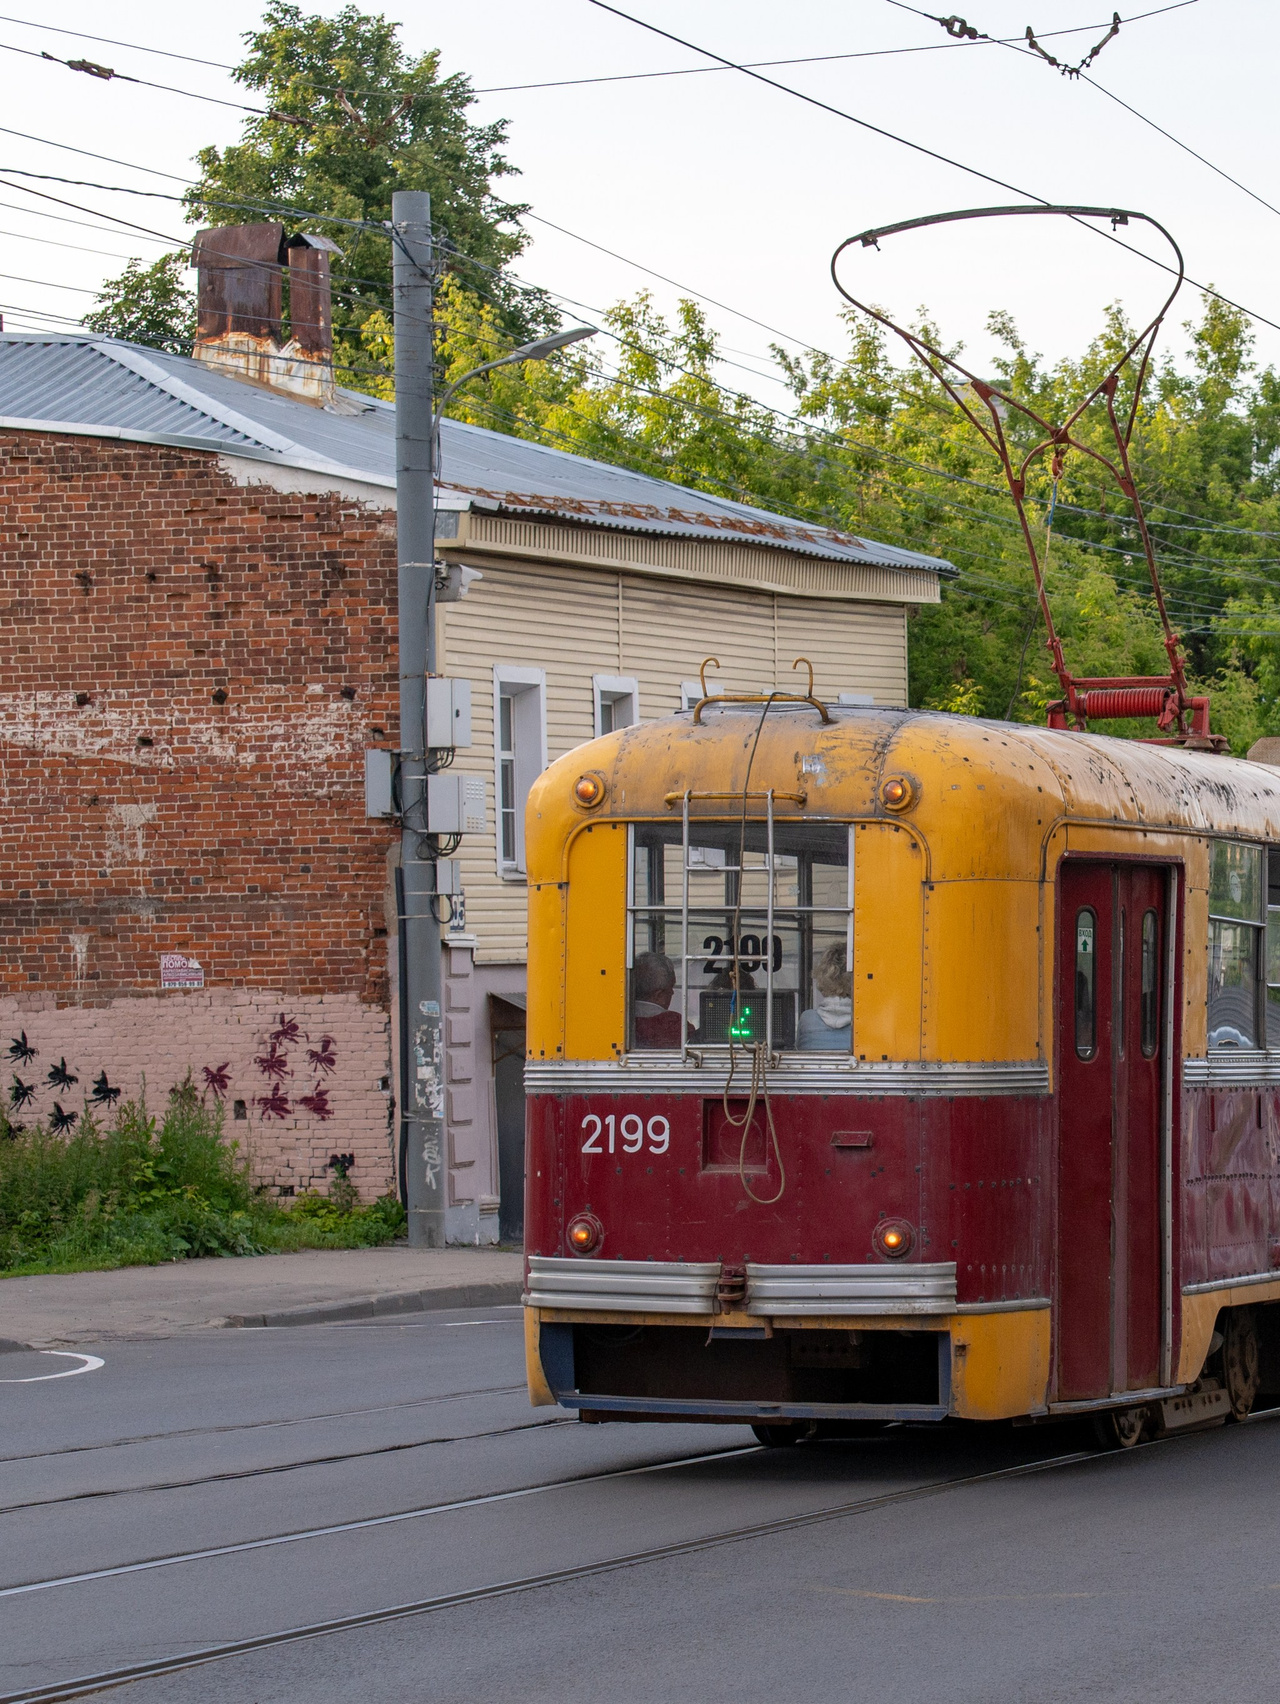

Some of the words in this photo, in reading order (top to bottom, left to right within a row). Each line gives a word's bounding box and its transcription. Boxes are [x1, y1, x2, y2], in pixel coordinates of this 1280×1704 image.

[450, 895, 465, 926] 05
[1079, 929, 1092, 938] ВХОД
[703, 934, 783, 974] 2199
[581, 1113, 670, 1155] 2199
